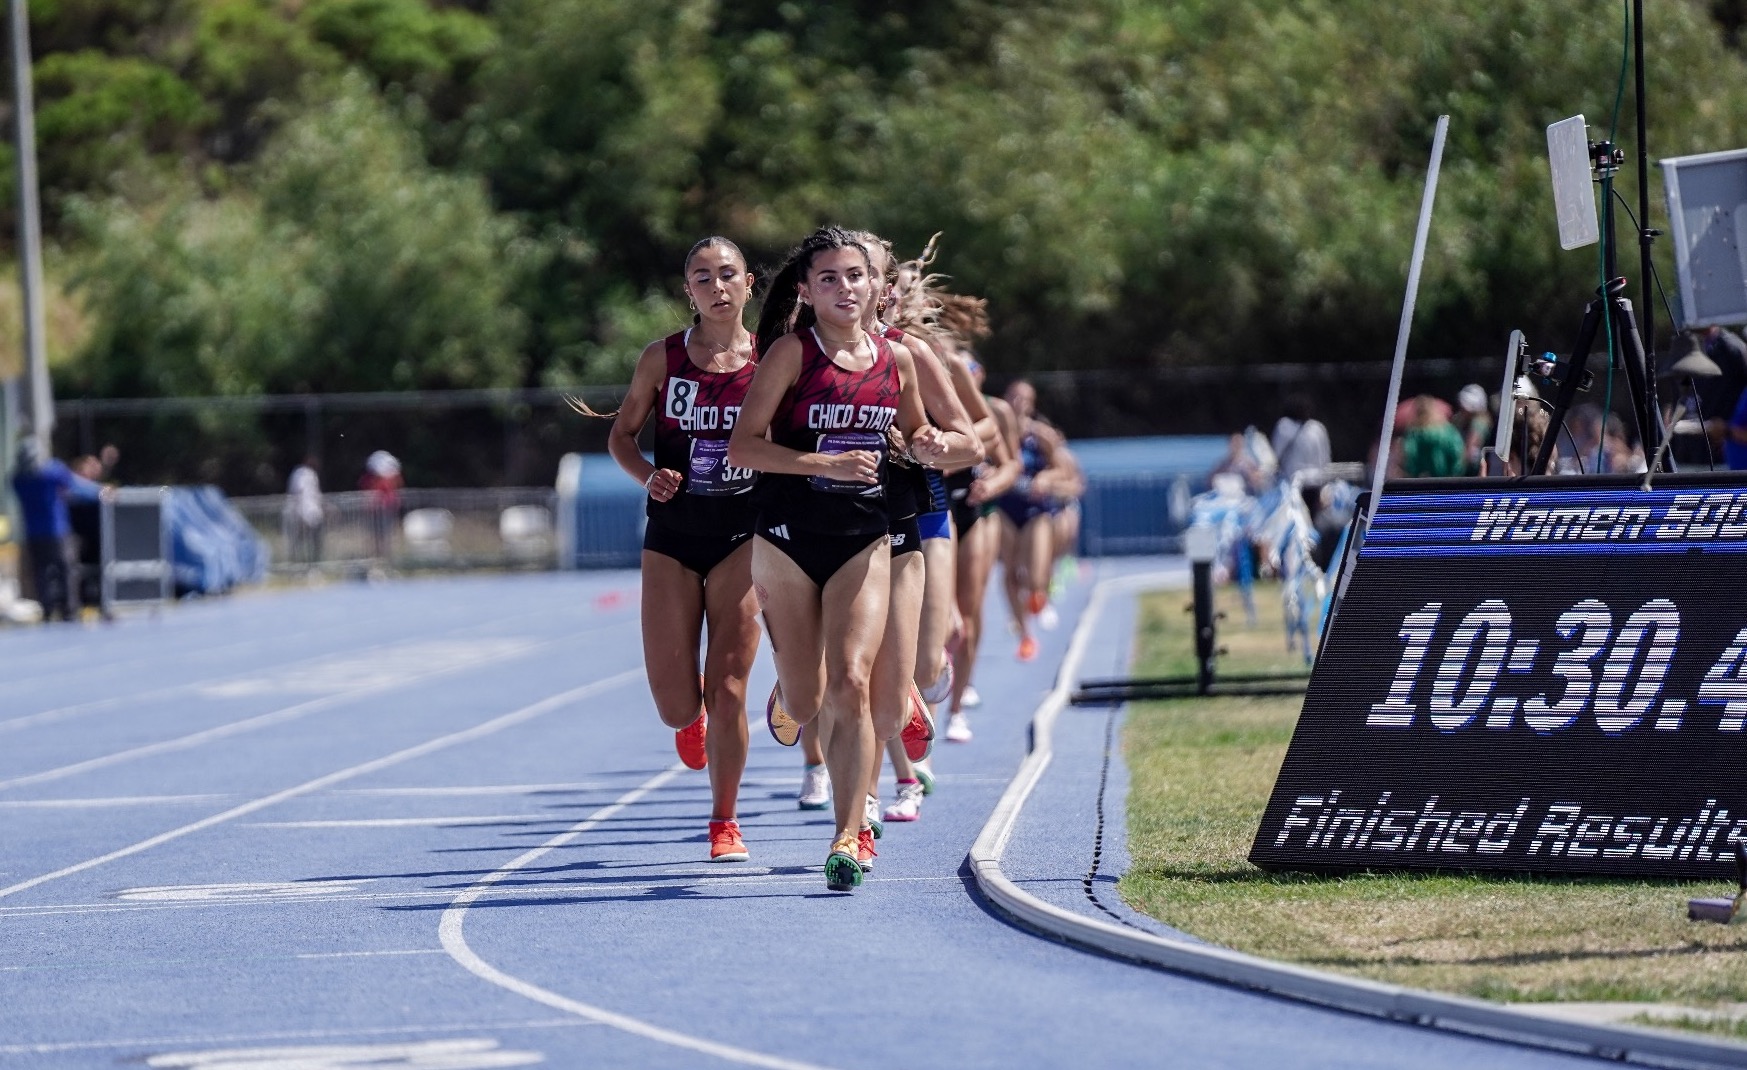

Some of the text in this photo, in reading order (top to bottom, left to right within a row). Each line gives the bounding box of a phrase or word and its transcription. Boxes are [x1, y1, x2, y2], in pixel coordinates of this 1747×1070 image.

[671, 381, 691, 417] 8
[808, 403, 898, 432] CHICO STATE
[1470, 497, 1652, 541] Women
[1273, 789, 1747, 862] Finished Results
